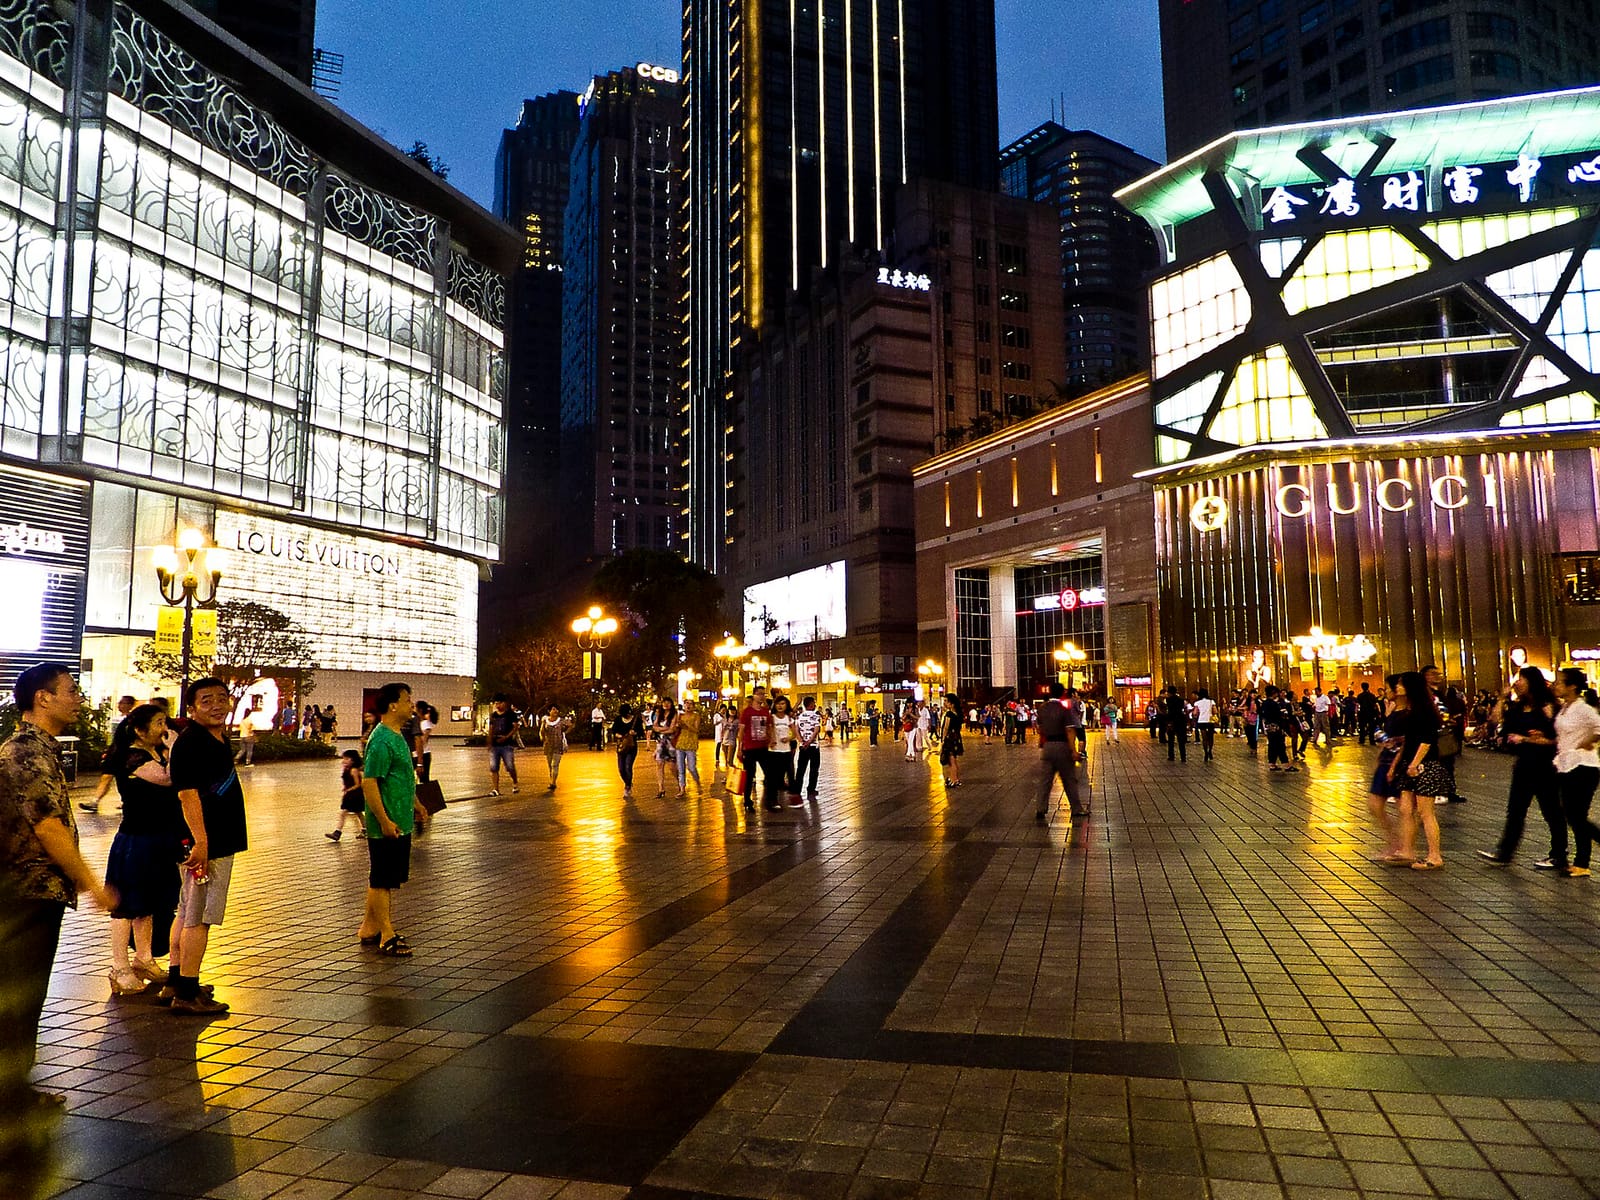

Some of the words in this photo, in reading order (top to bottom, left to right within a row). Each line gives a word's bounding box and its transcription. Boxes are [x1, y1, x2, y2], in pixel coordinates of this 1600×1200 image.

[637, 63, 678, 83] CCB
[1261, 151, 1600, 224] 金鹰财富中心
[1275, 473, 1497, 518] GUCCI
[236, 530, 306, 561] LOUIS
[315, 543, 400, 575] VUITTON
